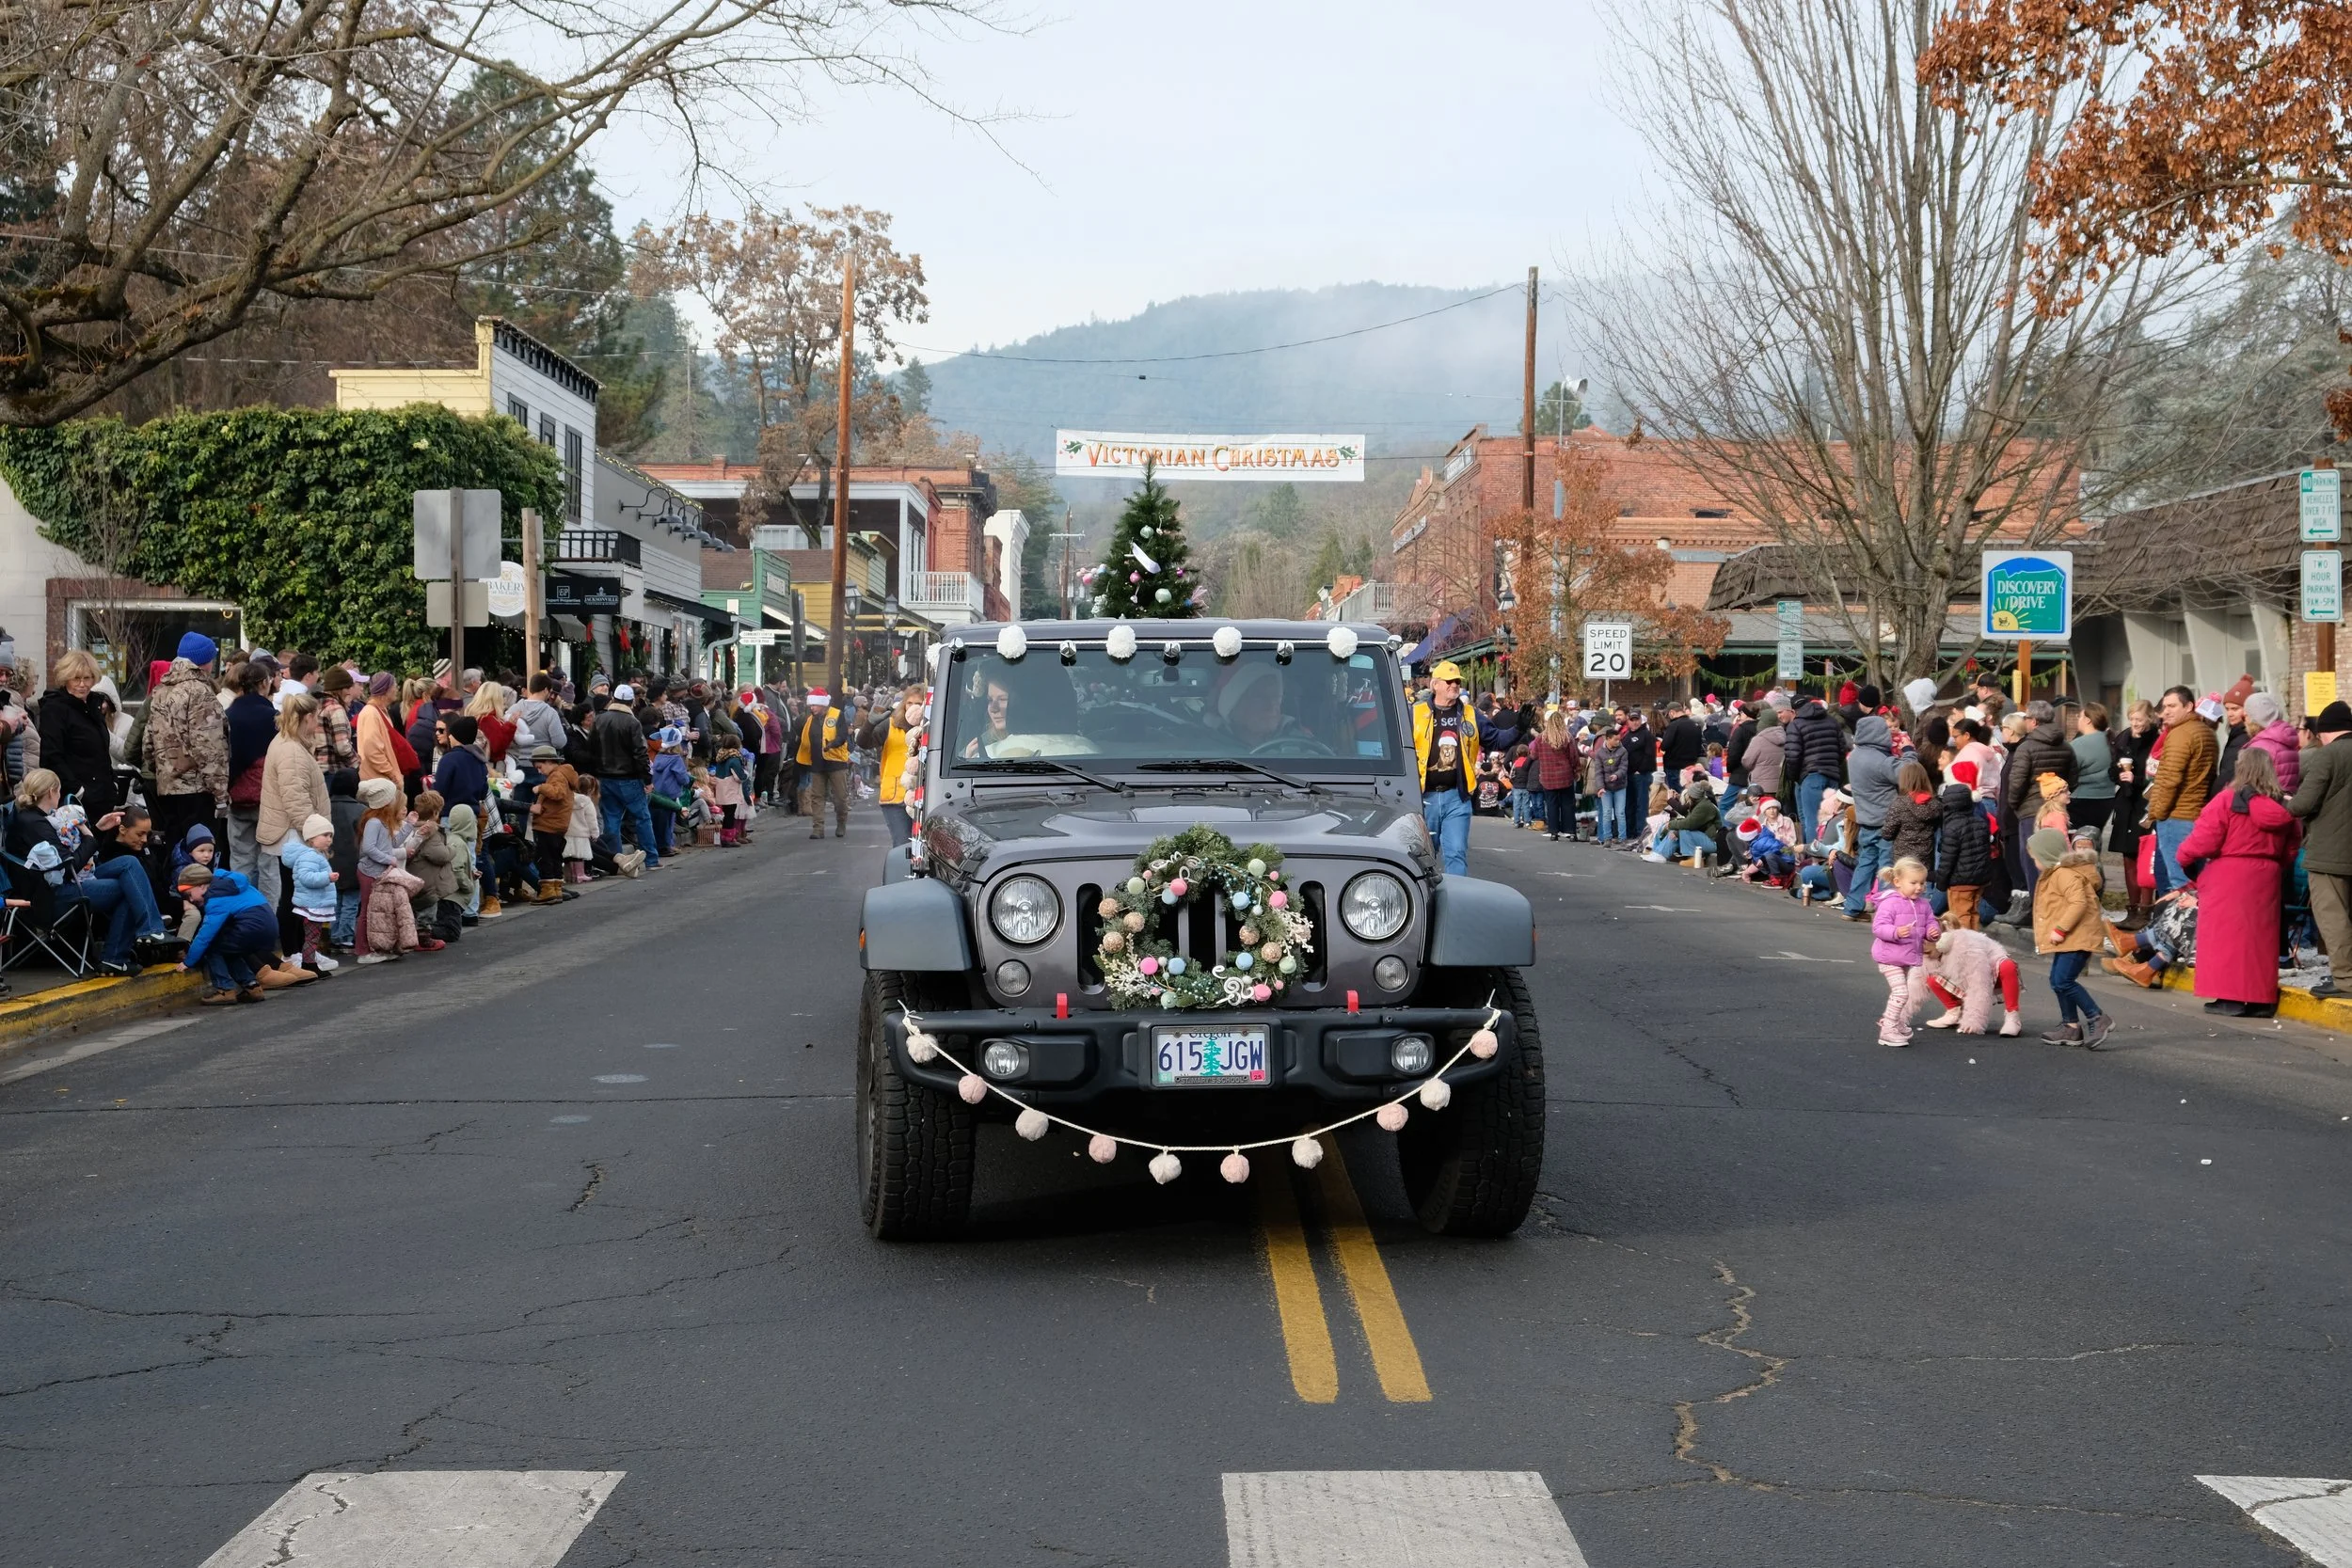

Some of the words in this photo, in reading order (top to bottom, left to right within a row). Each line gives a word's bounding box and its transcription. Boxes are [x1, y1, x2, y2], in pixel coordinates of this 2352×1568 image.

[1086, 443, 1206, 467] VICTORIAN
[1212, 445, 1340, 471] CHRISTMAS
[2307, 495, 2333, 503] VEHICLES
[2305, 507, 2319, 515] OVER
[2313, 518, 2327, 527] HIGH
[2312, 560, 2328, 568] TWO
[2311, 572, 2330, 580] HOUR
[1997, 580, 2058, 594] DISCOVERY
[2307, 585, 2335, 594] PARKING
[2010, 595, 2045, 609] DRIVE
[1590, 629, 1627, 638] SPEED
[1590, 653, 1625, 672] 20
[1158, 1041, 1202, 1071] 615
[1219, 1040, 1263, 1070] JGW
